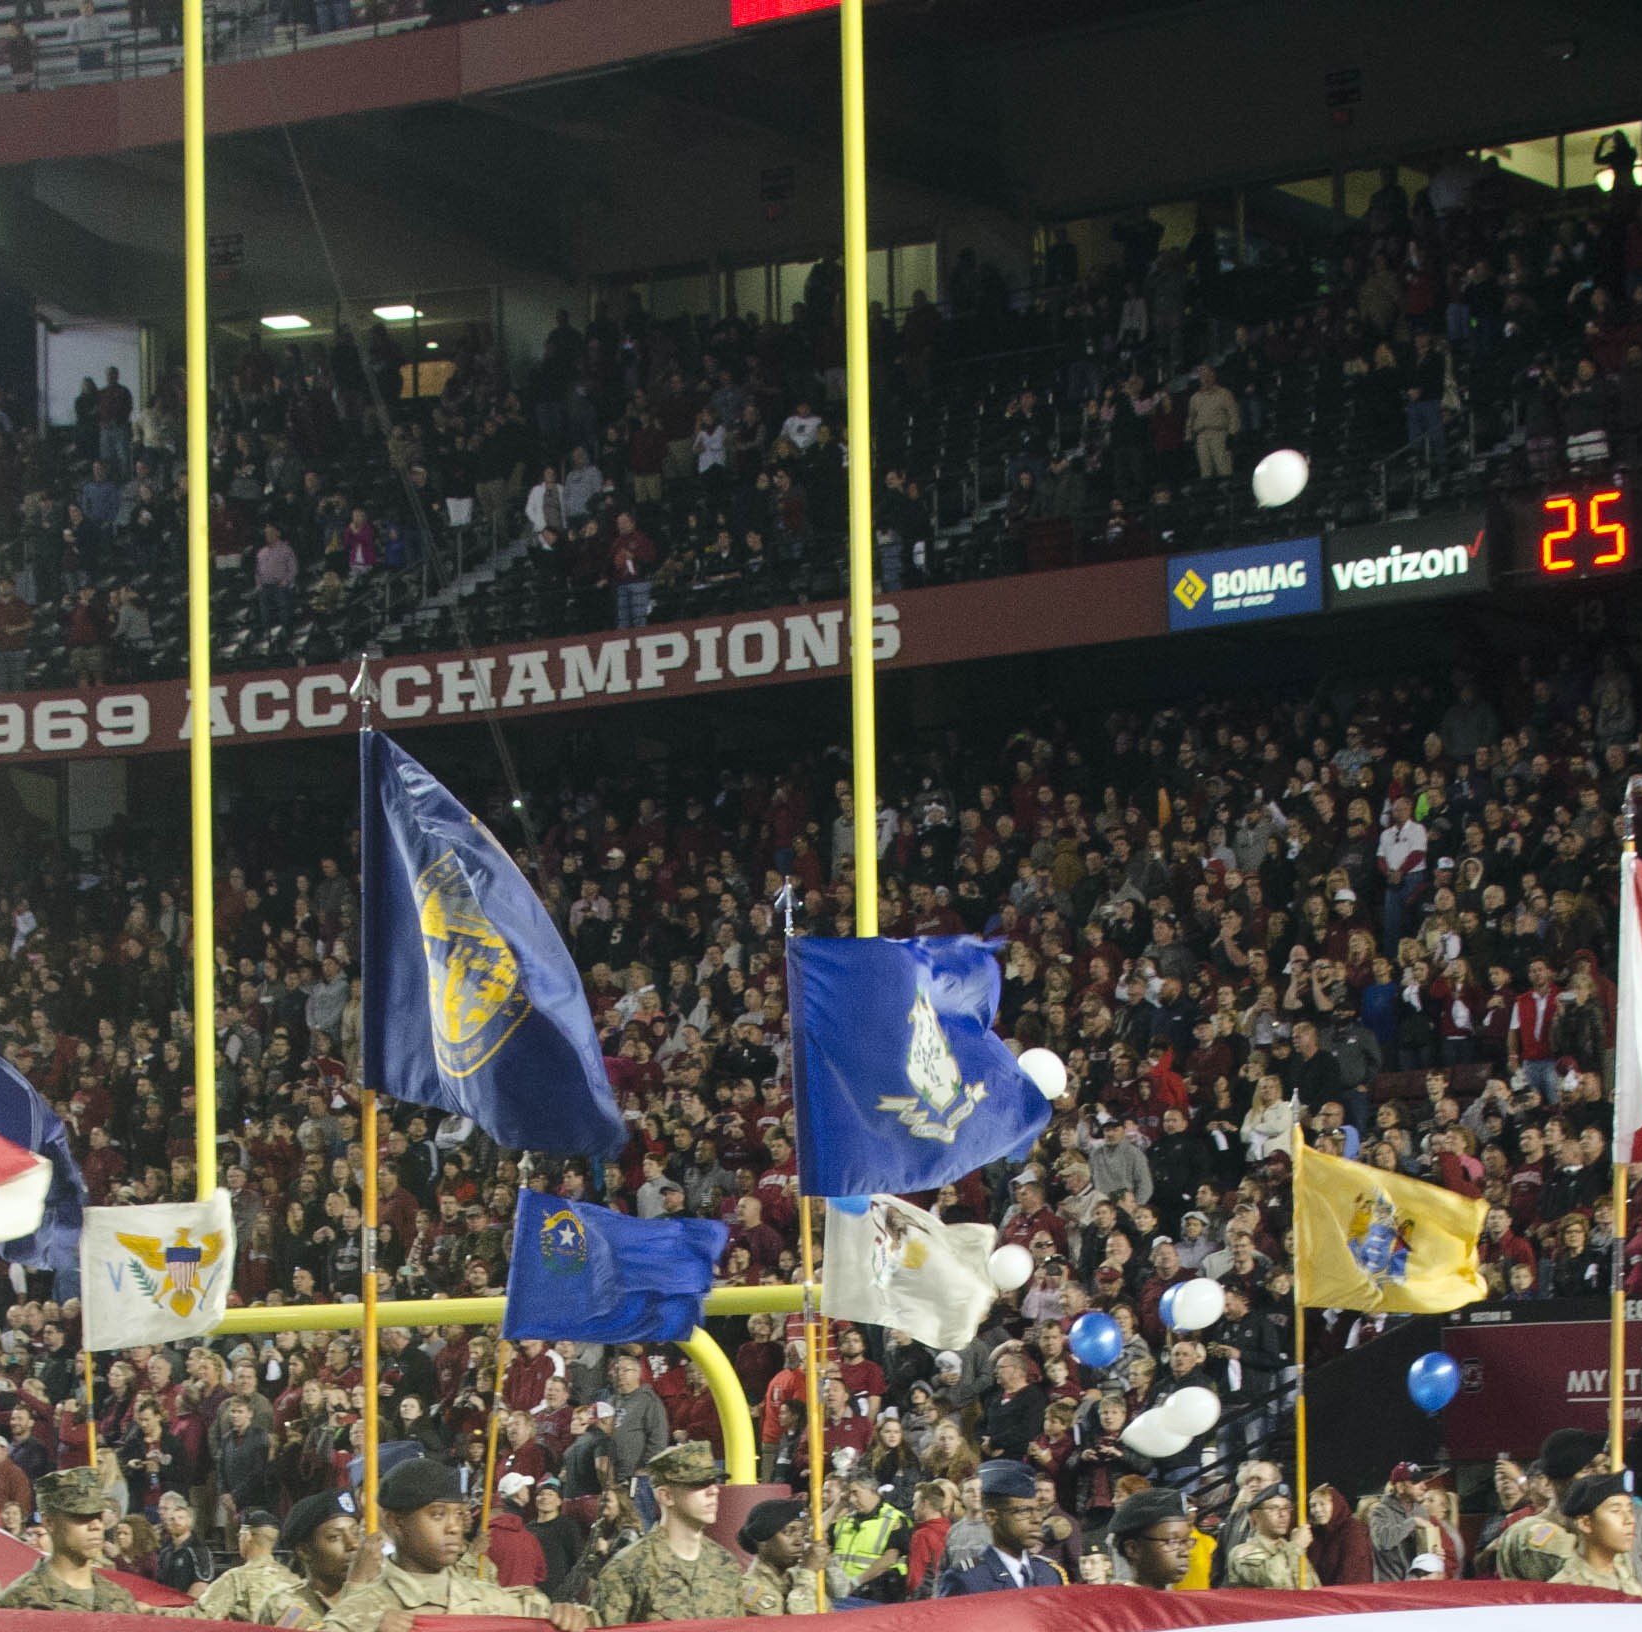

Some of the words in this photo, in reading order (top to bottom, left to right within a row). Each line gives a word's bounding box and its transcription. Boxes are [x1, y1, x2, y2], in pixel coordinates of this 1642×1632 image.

[1540, 490, 1628, 572] 25
[1211, 560, 1308, 599] BOMAG
[1331, 541, 1470, 593] verizon
[178, 673, 348, 740] ACC
[379, 603, 902, 720] CHAMPIONS
[105, 1260, 125, 1293] V
